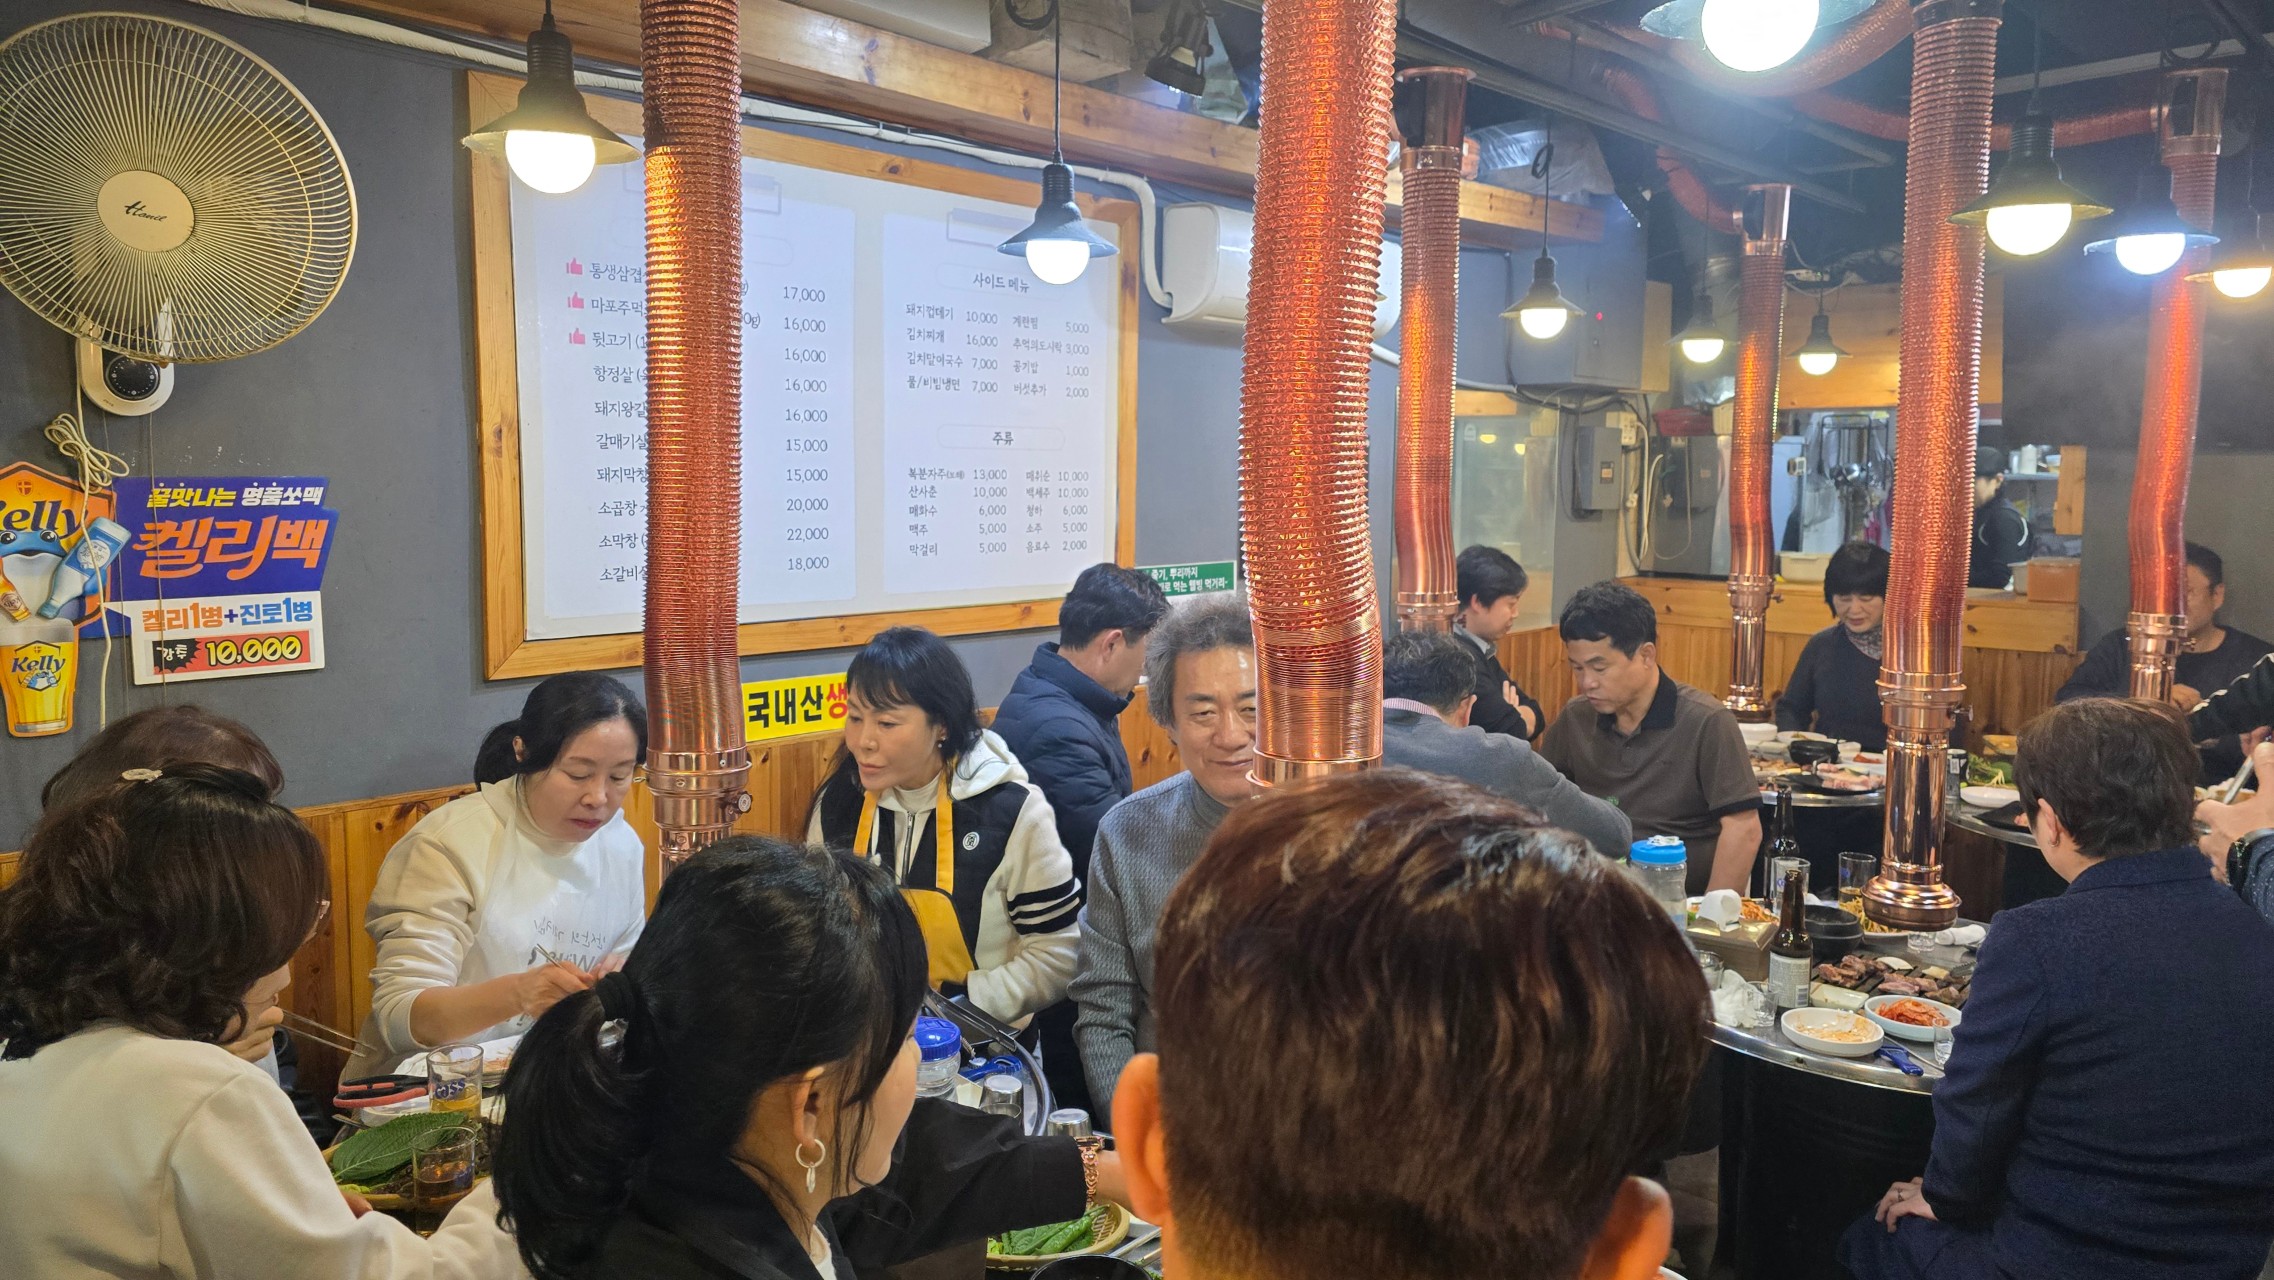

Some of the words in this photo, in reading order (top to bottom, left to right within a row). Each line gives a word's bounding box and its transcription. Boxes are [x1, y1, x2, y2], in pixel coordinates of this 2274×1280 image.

[590, 262, 647, 283] 통생삼겹
[783, 286, 826, 304] 17,000
[973, 272, 1005, 289] 사이드
[1009, 277, 1030, 293] 메뉴
[591, 297, 647, 317] 마포주먹
[784, 317, 827, 333] 16,000
[966, 310, 998, 324] 10,000
[1065, 321, 1089, 333] 5,000
[907, 327, 945, 343] 김치찌개
[966, 334, 998, 347] 16,000
[592, 332, 632, 349] 뒷고기
[785, 348, 827, 363] 16,000
[1013, 338, 1062, 354] 추억의도시락
[1066, 344, 1089, 355] 3,000
[907, 352, 963, 368] 김치말이국수
[972, 357, 998, 370] 7,000
[1013, 360, 1039, 374] 공기밥
[1066, 366, 1089, 377] 1,000
[593, 365, 633, 384] 항정살
[785, 378, 827, 393] 16,000
[972, 381, 998, 393] 7,000
[1014, 383, 1047, 397] 버섯추가
[1066, 387, 1089, 398] 2,000
[785, 409, 827, 423] 16,000
[786, 439, 828, 452] 15,000
[992, 431, 1014, 446] 주류
[786, 468, 828, 482] 15,000
[973, 469, 1007, 481] 13,000
[1058, 471, 1089, 482] 10,000
[146, 485, 237, 508] 꿀맛나는
[241, 485, 324, 506] 명품쏘맥
[908, 485, 938, 498] 산사춘
[973, 487, 1008, 499] 10,000
[1026, 487, 1051, 498] 백세주
[1058, 487, 1089, 499] 10,000
[598, 500, 637, 516] 소곱창
[786, 498, 828, 512] 20,000
[909, 504, 938, 517] 매화수
[979, 505, 1007, 517] 6,000
[1063, 505, 1088, 517] 6,000
[0, 500, 88, 539] elly
[909, 523, 929, 537] 맥주
[979, 523, 1007, 535] 5,000
[1026, 523, 1043, 534] 소주
[1063, 522, 1088, 534] 5,000
[599, 533, 638, 549] 소막창
[787, 527, 829, 542] 22,000
[132, 515, 329, 580] 켈리백
[909, 543, 938, 556] 막걸리
[979, 542, 1007, 554] 5,000
[1026, 541, 1051, 554] 음료수
[1062, 540, 1088, 552] 2,000
[788, 557, 829, 571] 18,000
[142, 597, 313, 632] 켈리1병+진로1병
[156, 643, 188, 661] 강추
[205, 635, 302, 667] 10,000
[11, 655, 66, 674] Kelly
